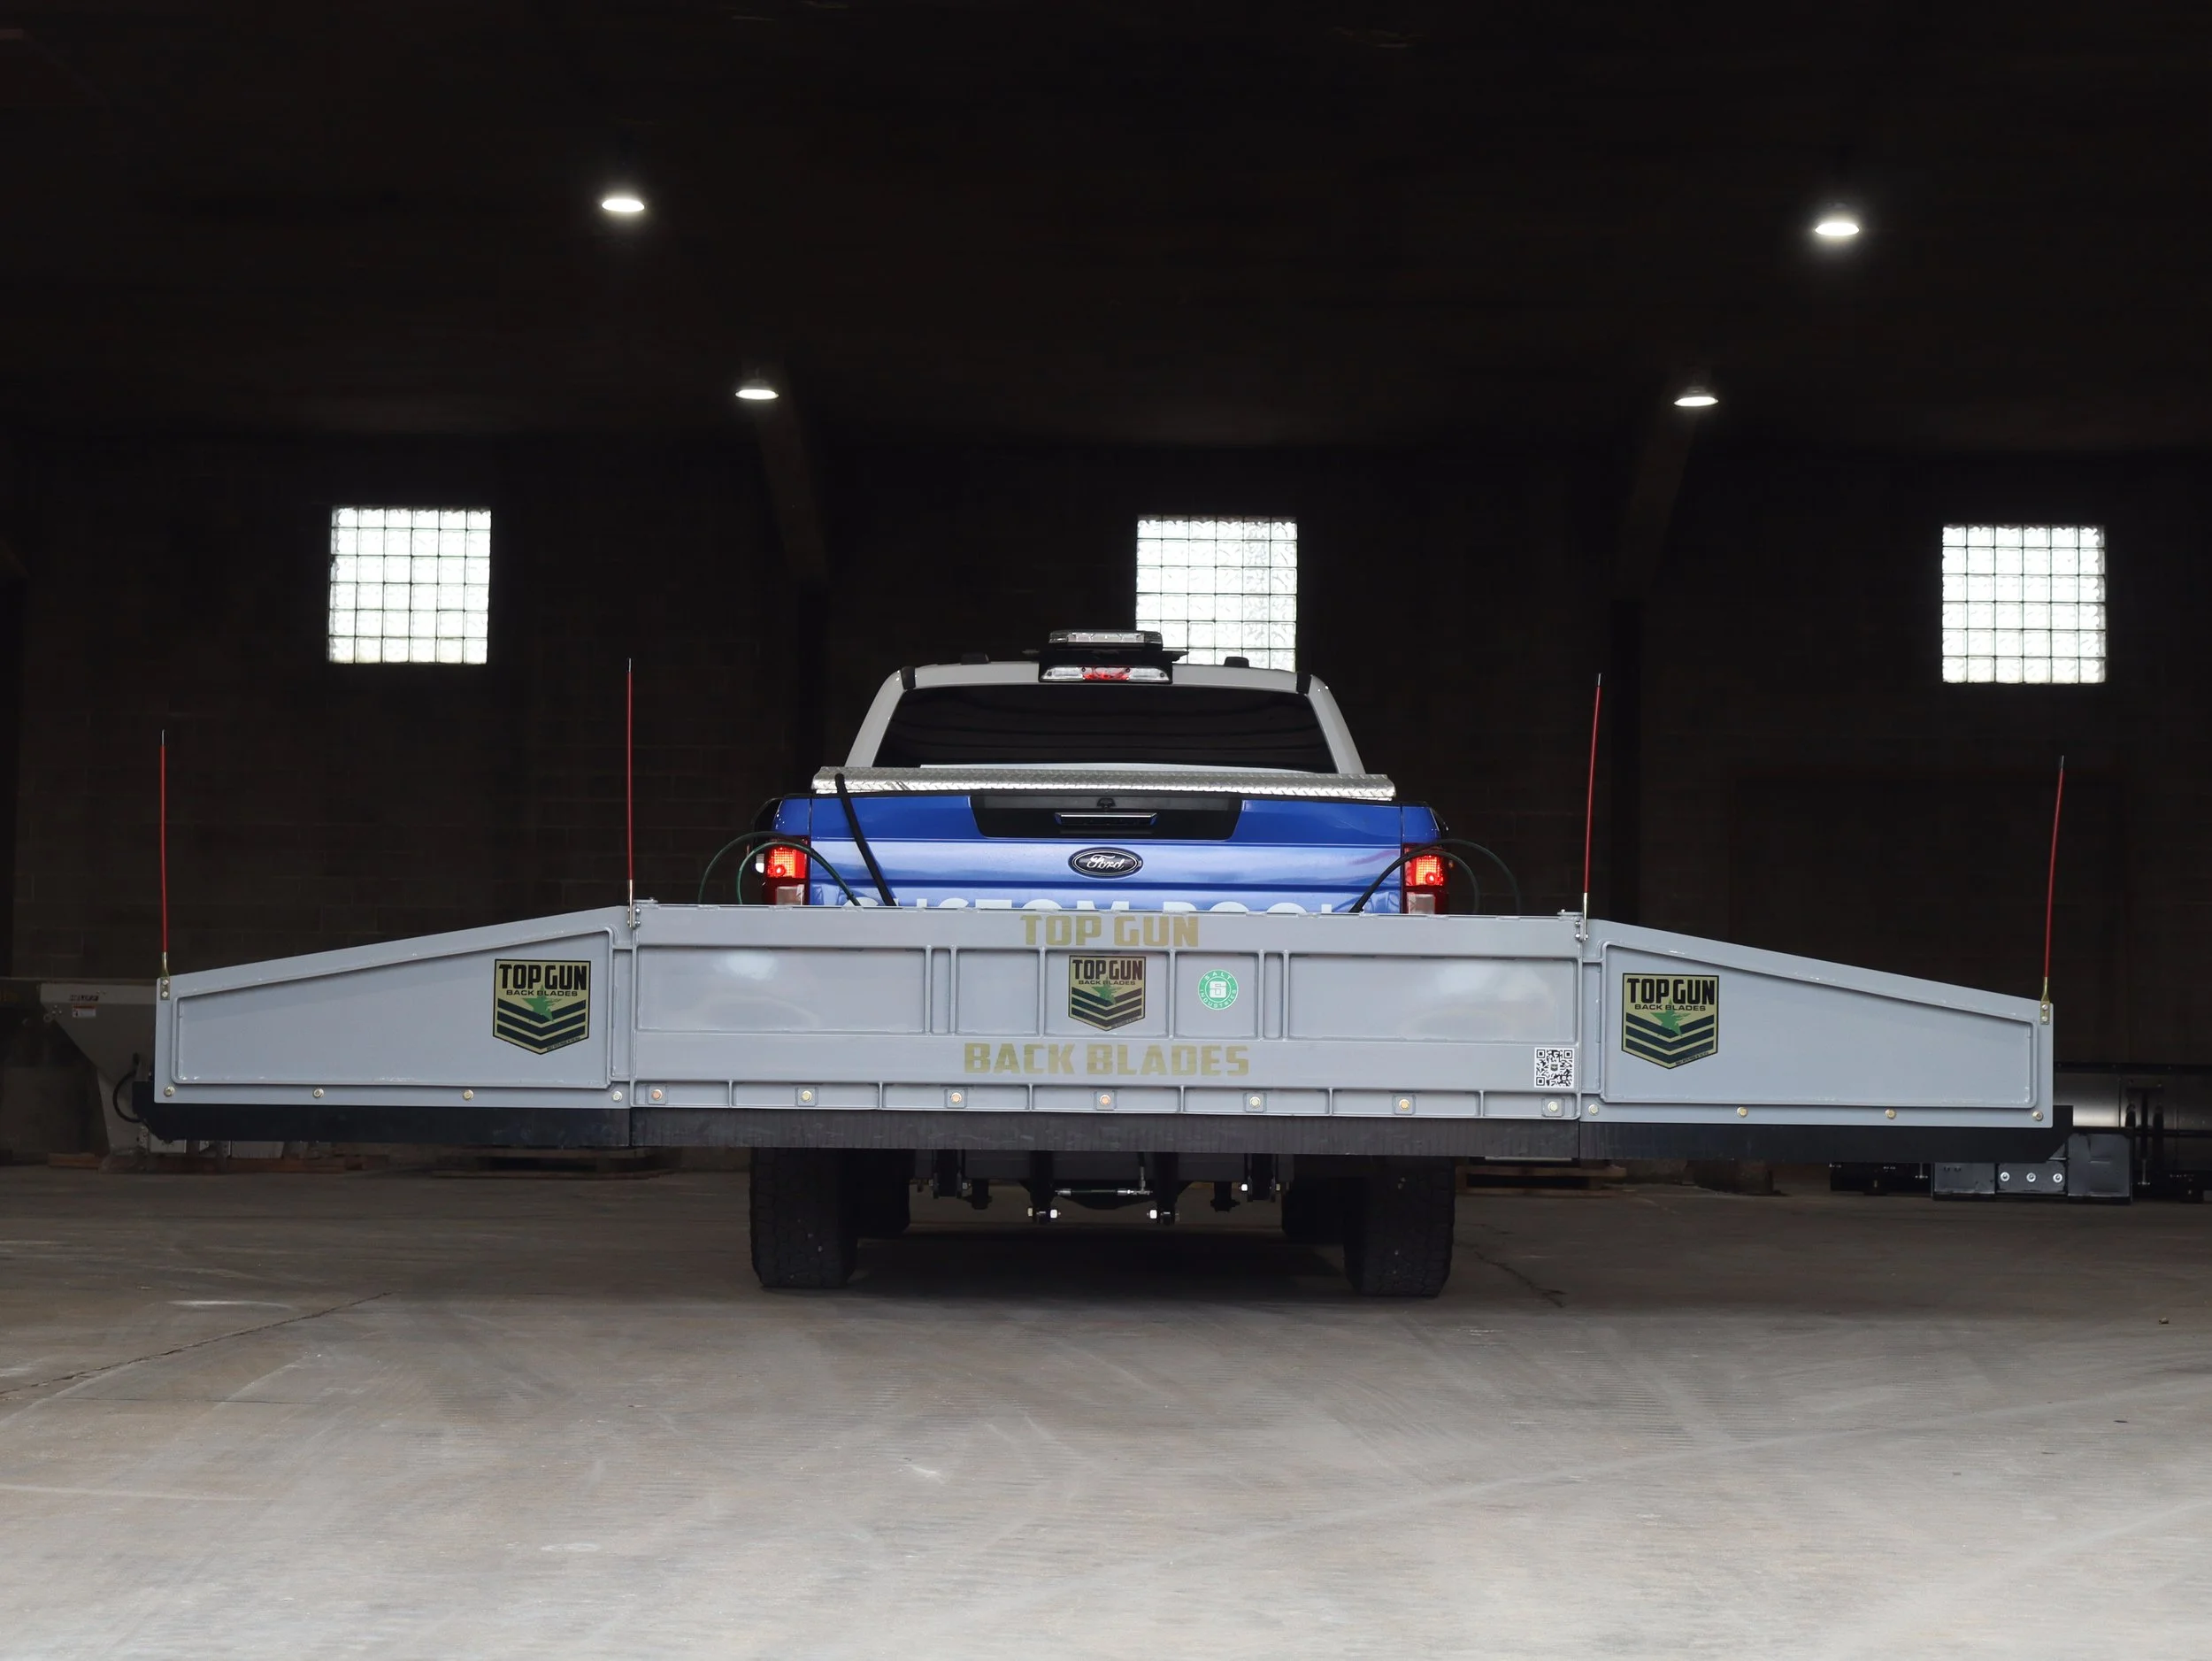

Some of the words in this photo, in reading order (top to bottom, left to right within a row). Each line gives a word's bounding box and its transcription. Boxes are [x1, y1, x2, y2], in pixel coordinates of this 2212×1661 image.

[1087, 854, 1125, 870] Ford
[1020, 915, 1102, 946] TOP
[1114, 916, 1199, 947] GUN
[499, 964, 541, 989] TOP
[544, 965, 588, 990] GUN
[1072, 959, 1106, 980] TOP
[1109, 960, 1143, 980] GUN
[1204, 972, 1231, 980] SALT
[1199, 989, 1237, 1009] INDUSTRIES
[1626, 978, 1670, 1004] TOP
[1672, 979, 1715, 1005] GUN
[964, 1042, 1076, 1074] BACK
[1087, 1043, 1249, 1076] BLADES
